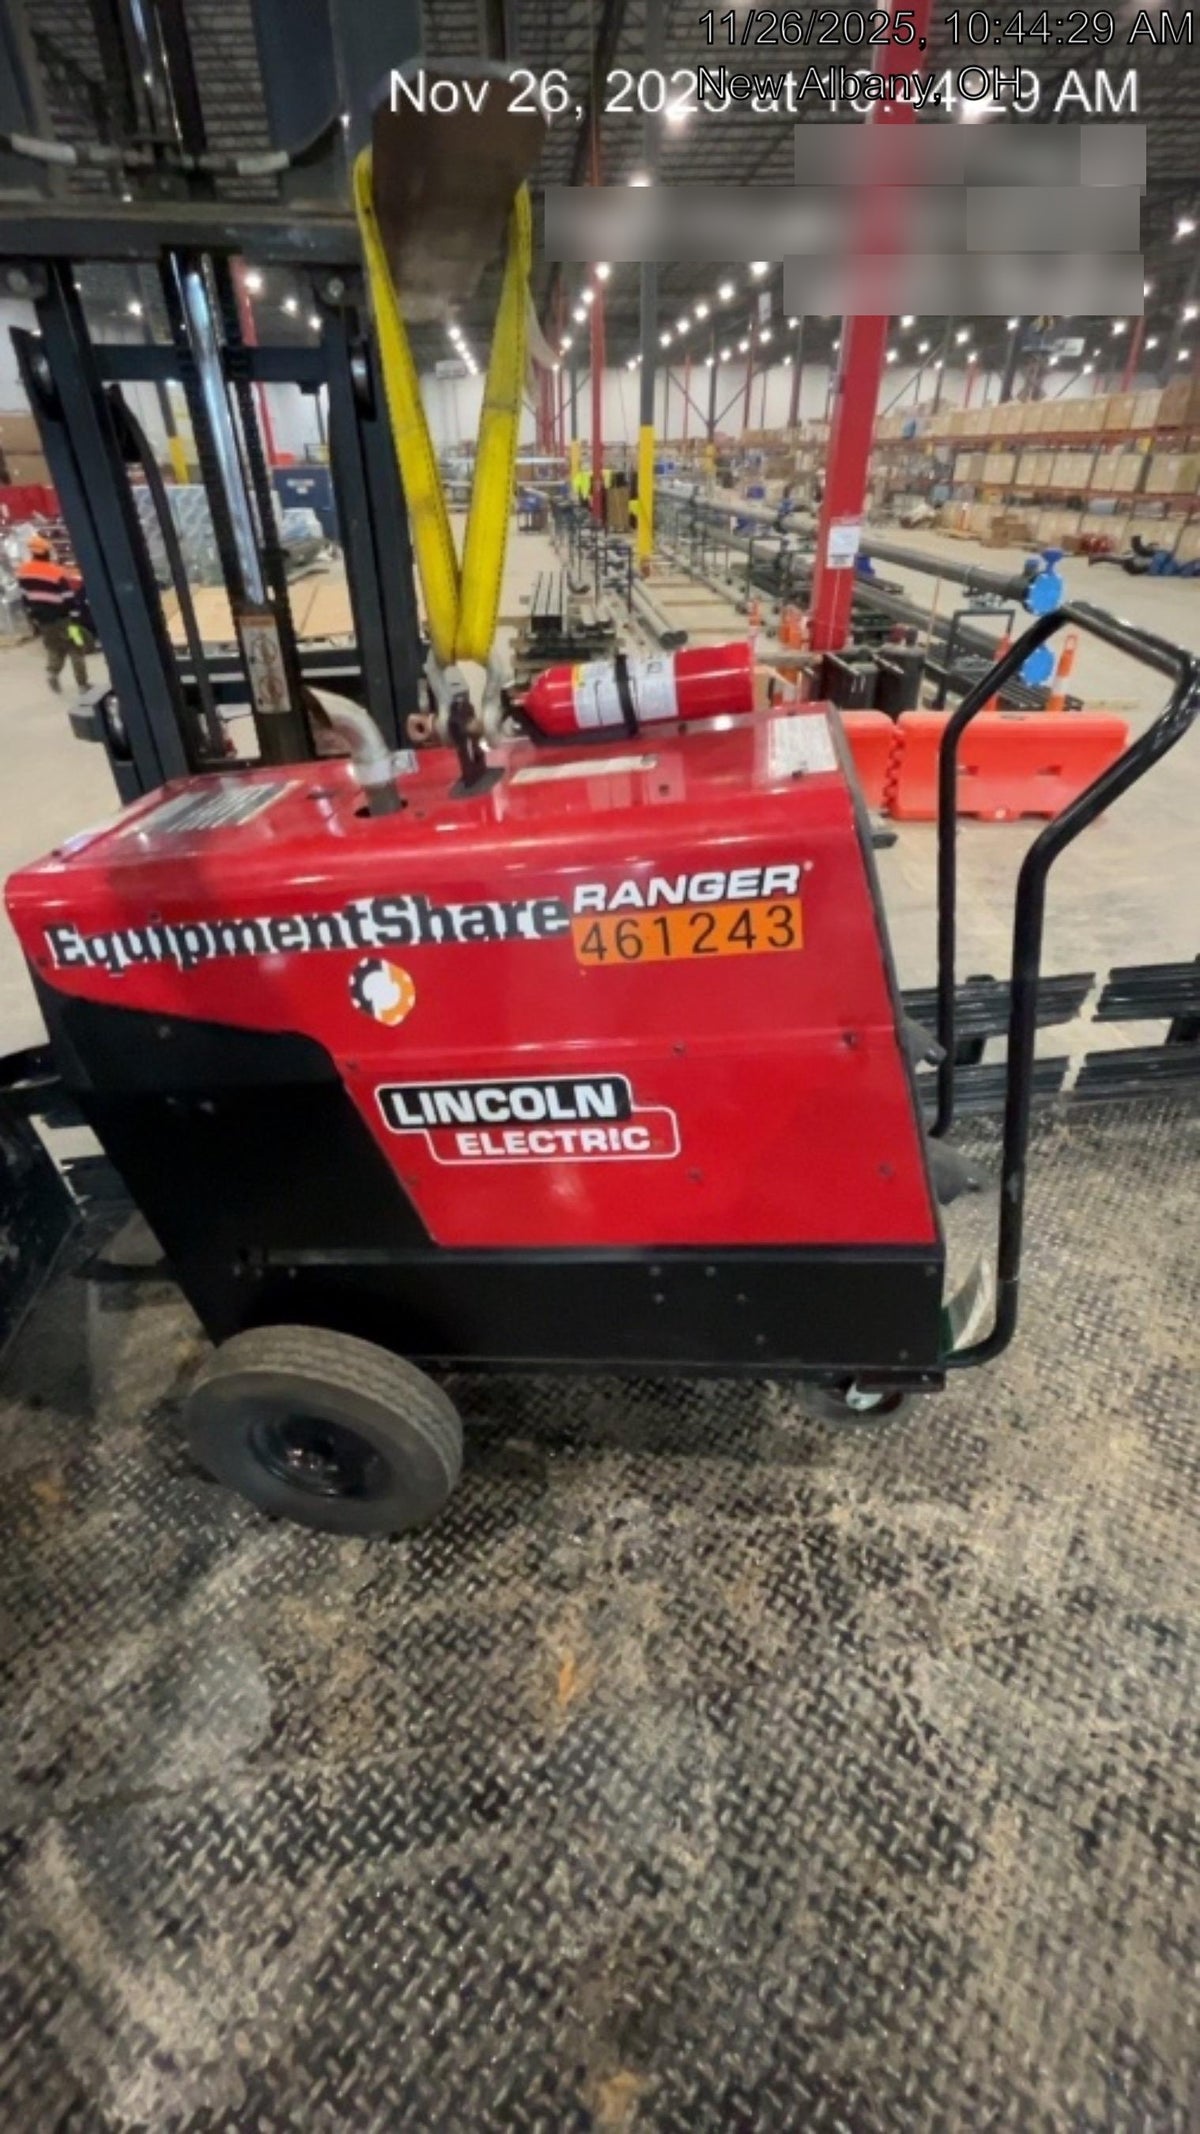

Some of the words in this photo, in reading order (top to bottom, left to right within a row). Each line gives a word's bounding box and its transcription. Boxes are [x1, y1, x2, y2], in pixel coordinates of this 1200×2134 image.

[573, 864, 801, 914] RANGER
[46, 894, 570, 976] EquipmentShare
[580, 904, 796, 961] 461243
[391, 1082, 618, 1126] LINCOLN
[455, 1125, 651, 1156] ELECTRIC
